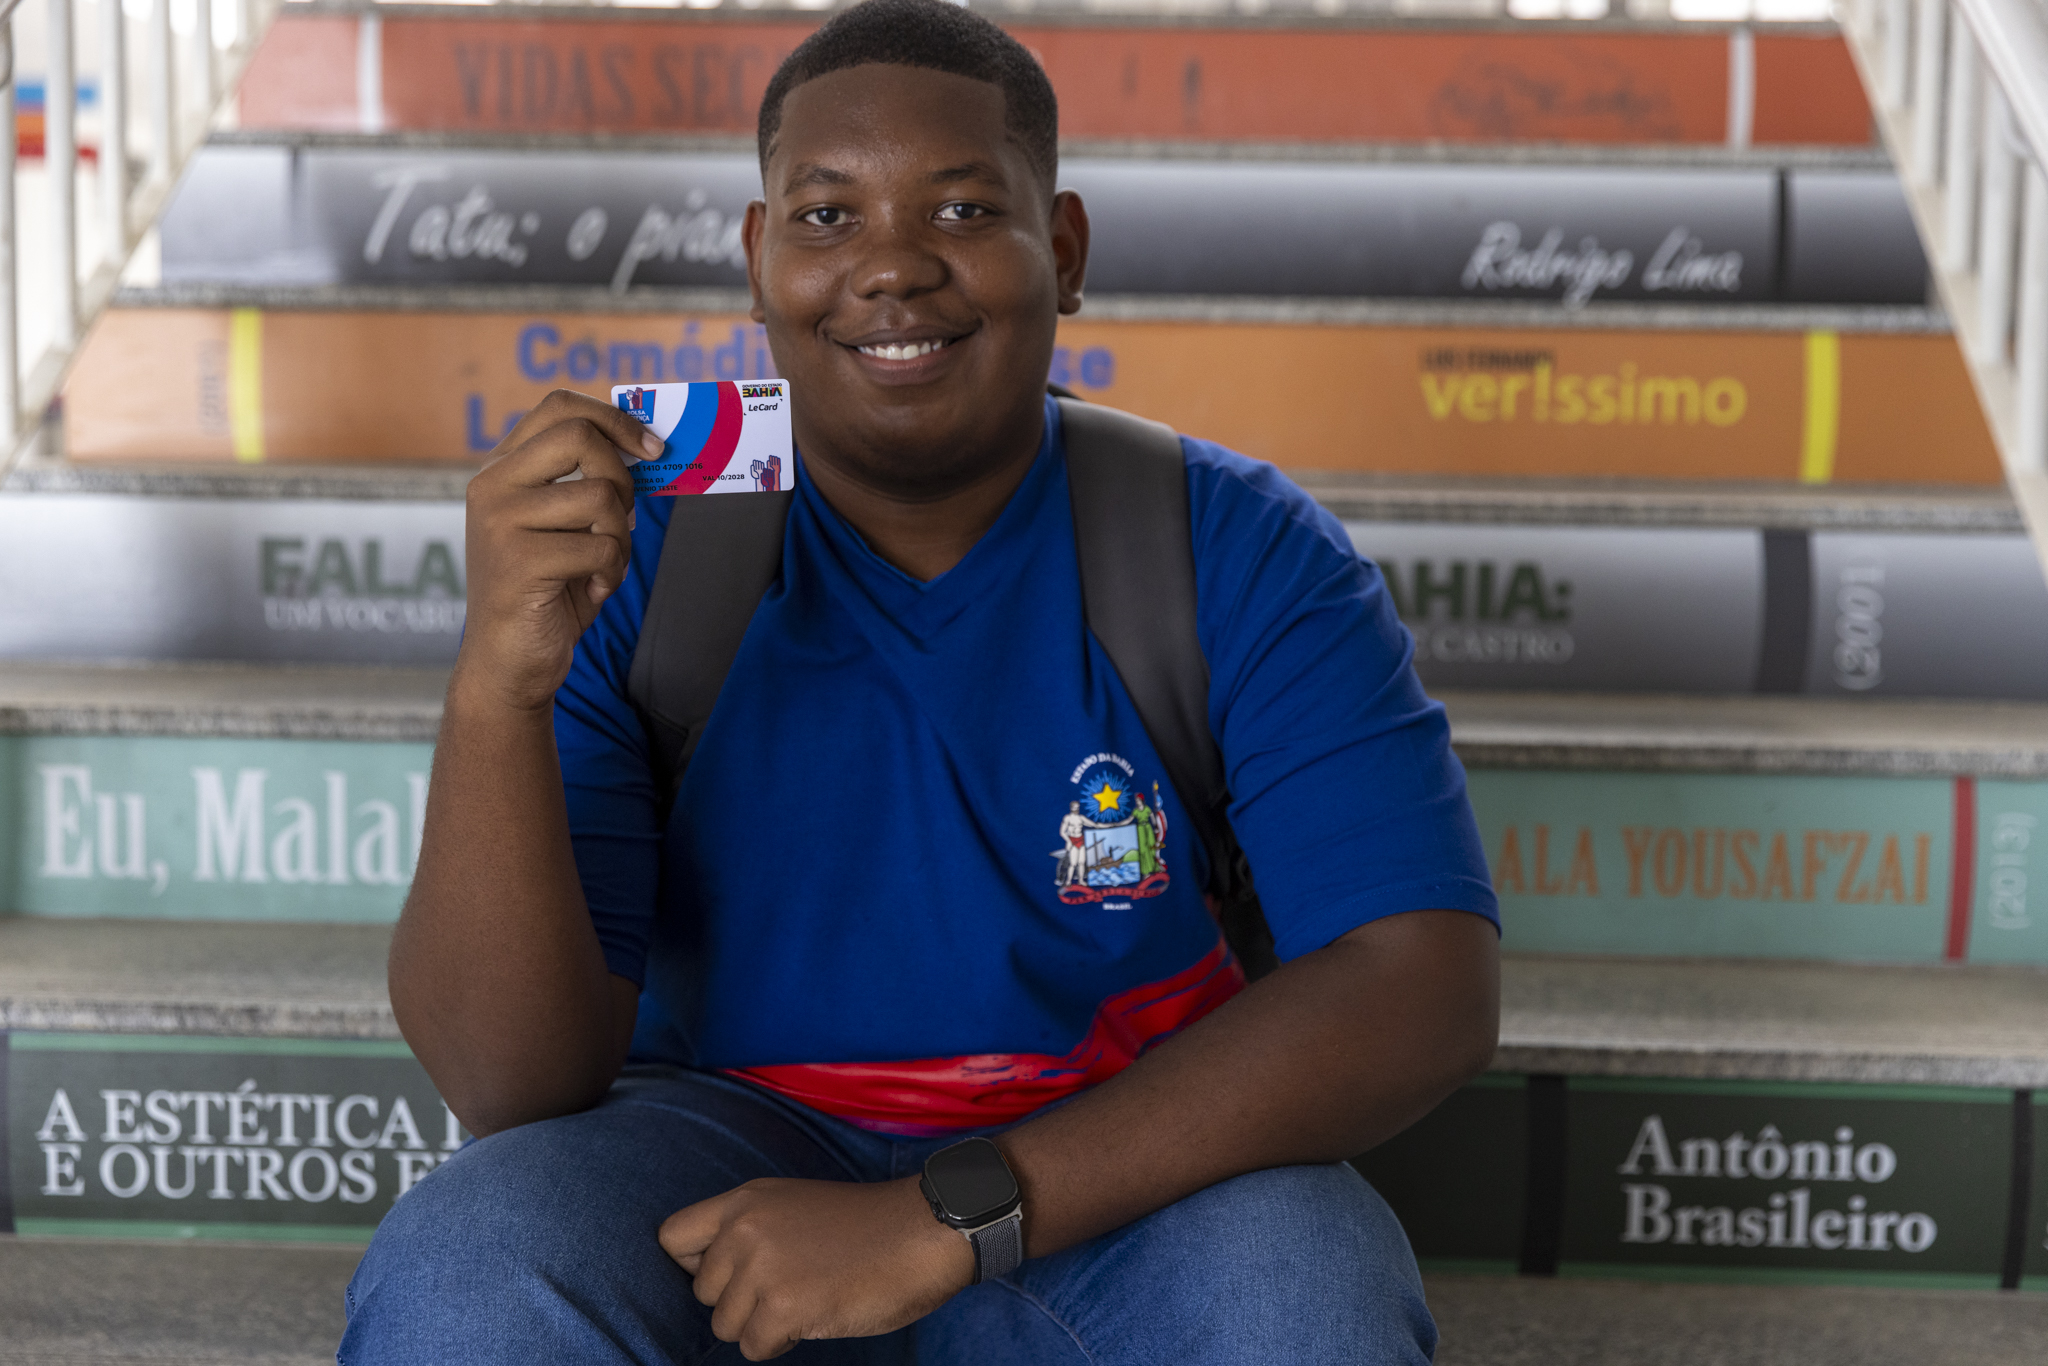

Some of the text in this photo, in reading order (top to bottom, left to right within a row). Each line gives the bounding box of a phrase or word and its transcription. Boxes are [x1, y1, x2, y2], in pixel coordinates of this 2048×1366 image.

[454, 42, 634, 124] VIDAS
[566, 206, 609, 264] o
[1460, 220, 1743, 310] Rodrigo Lima
[626, 410, 646, 418] BOLSA
[663, 463, 683, 471] 4709
[685, 462, 703, 470] 1016
[260, 537, 466, 599] FALA
[38, 764, 170, 897] Eu,
[36, 1087, 88, 1142] A
[100, 1078, 427, 1150] ESTÉTICA
[1616, 1114, 1898, 1184] Antônio
[40, 1143, 86, 1196] E
[100, 1143, 378, 1203] OUTROS
[1619, 1183, 1938, 1253] Brasileiro
